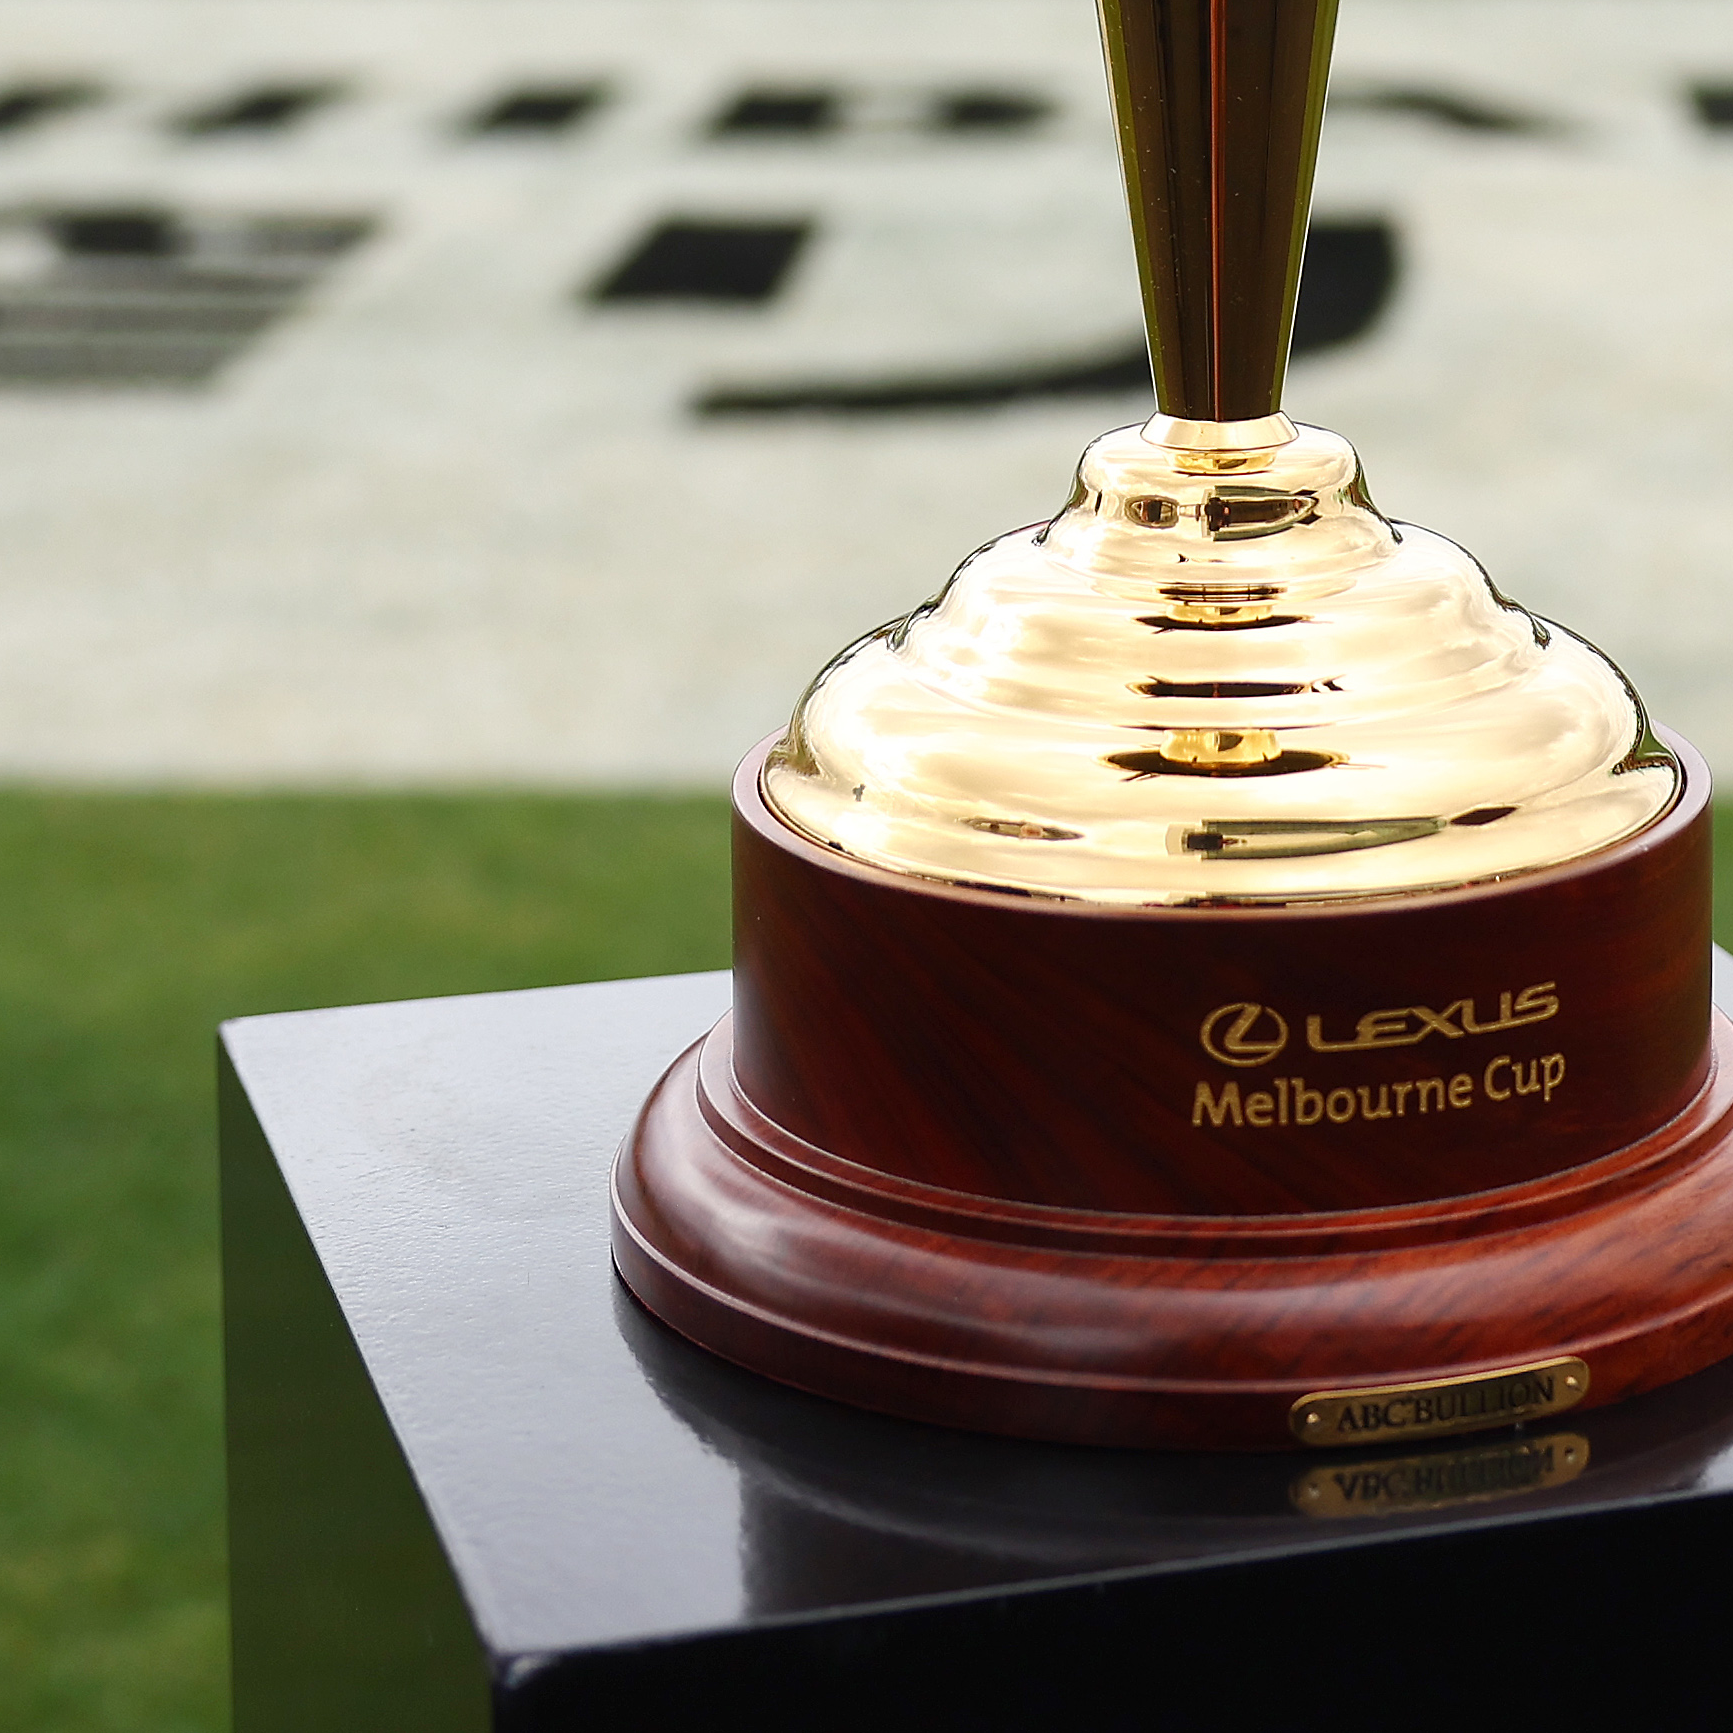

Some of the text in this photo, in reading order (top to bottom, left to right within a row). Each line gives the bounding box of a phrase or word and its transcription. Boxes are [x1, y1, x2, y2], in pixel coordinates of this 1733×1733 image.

[1306, 981, 1560, 1053] LEXUS
[1192, 1052, 1566, 1127] Melbourne Cup
[1338, 1376, 1556, 1432] ABC BULLION
